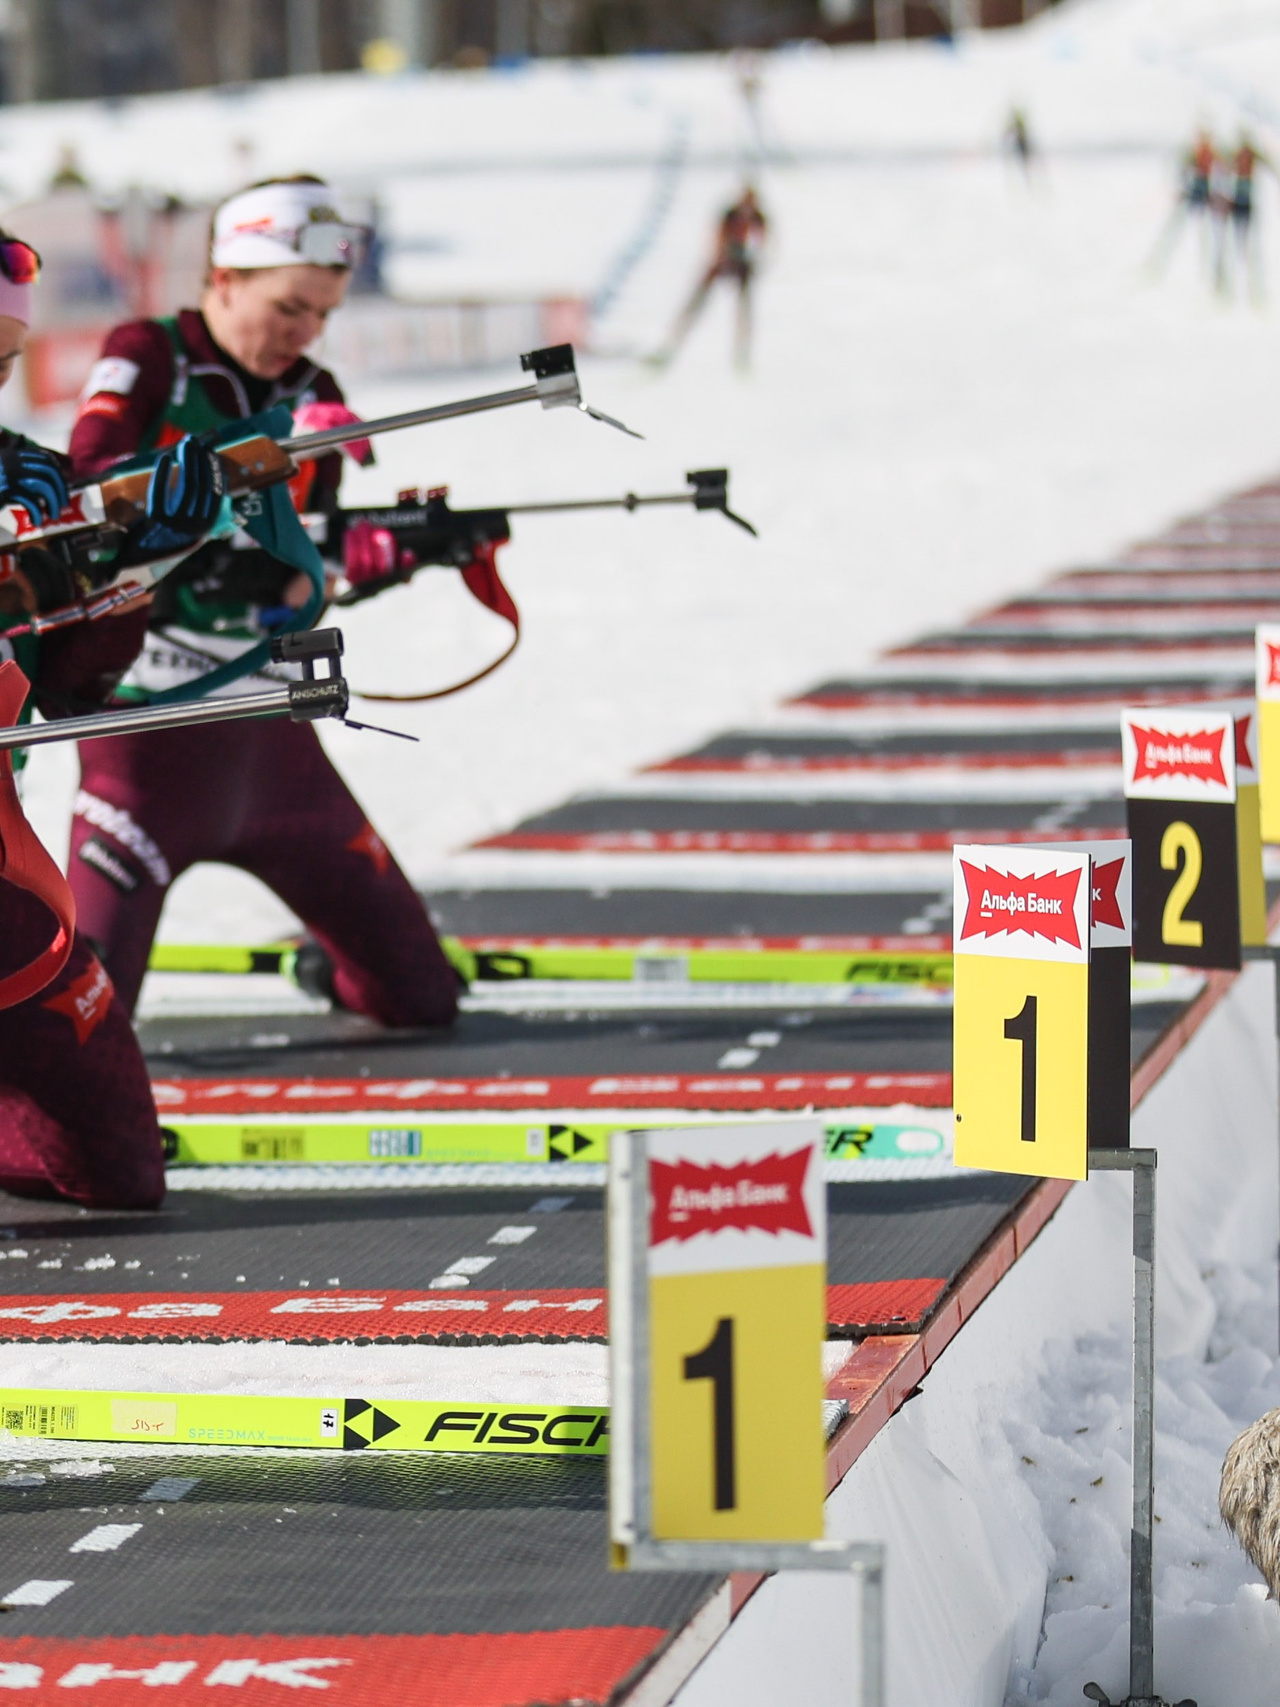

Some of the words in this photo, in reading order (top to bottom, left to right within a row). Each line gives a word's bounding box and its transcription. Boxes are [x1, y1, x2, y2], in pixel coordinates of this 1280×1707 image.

[1145, 741, 1181, 768] Альфа
[1160, 820, 1203, 947] 2
[979, 889, 1026, 918] Альфа
[1027, 892, 1063, 915] Банк
[1003, 995, 1038, 1143] 1
[668, 1185, 734, 1222] Альфа
[736, 1179, 788, 1208] Банк
[270, 1297, 603, 1314] Бан
[683, 1317, 736, 1511] 1
[188, 1427, 266, 1441] SPEEDMAX
